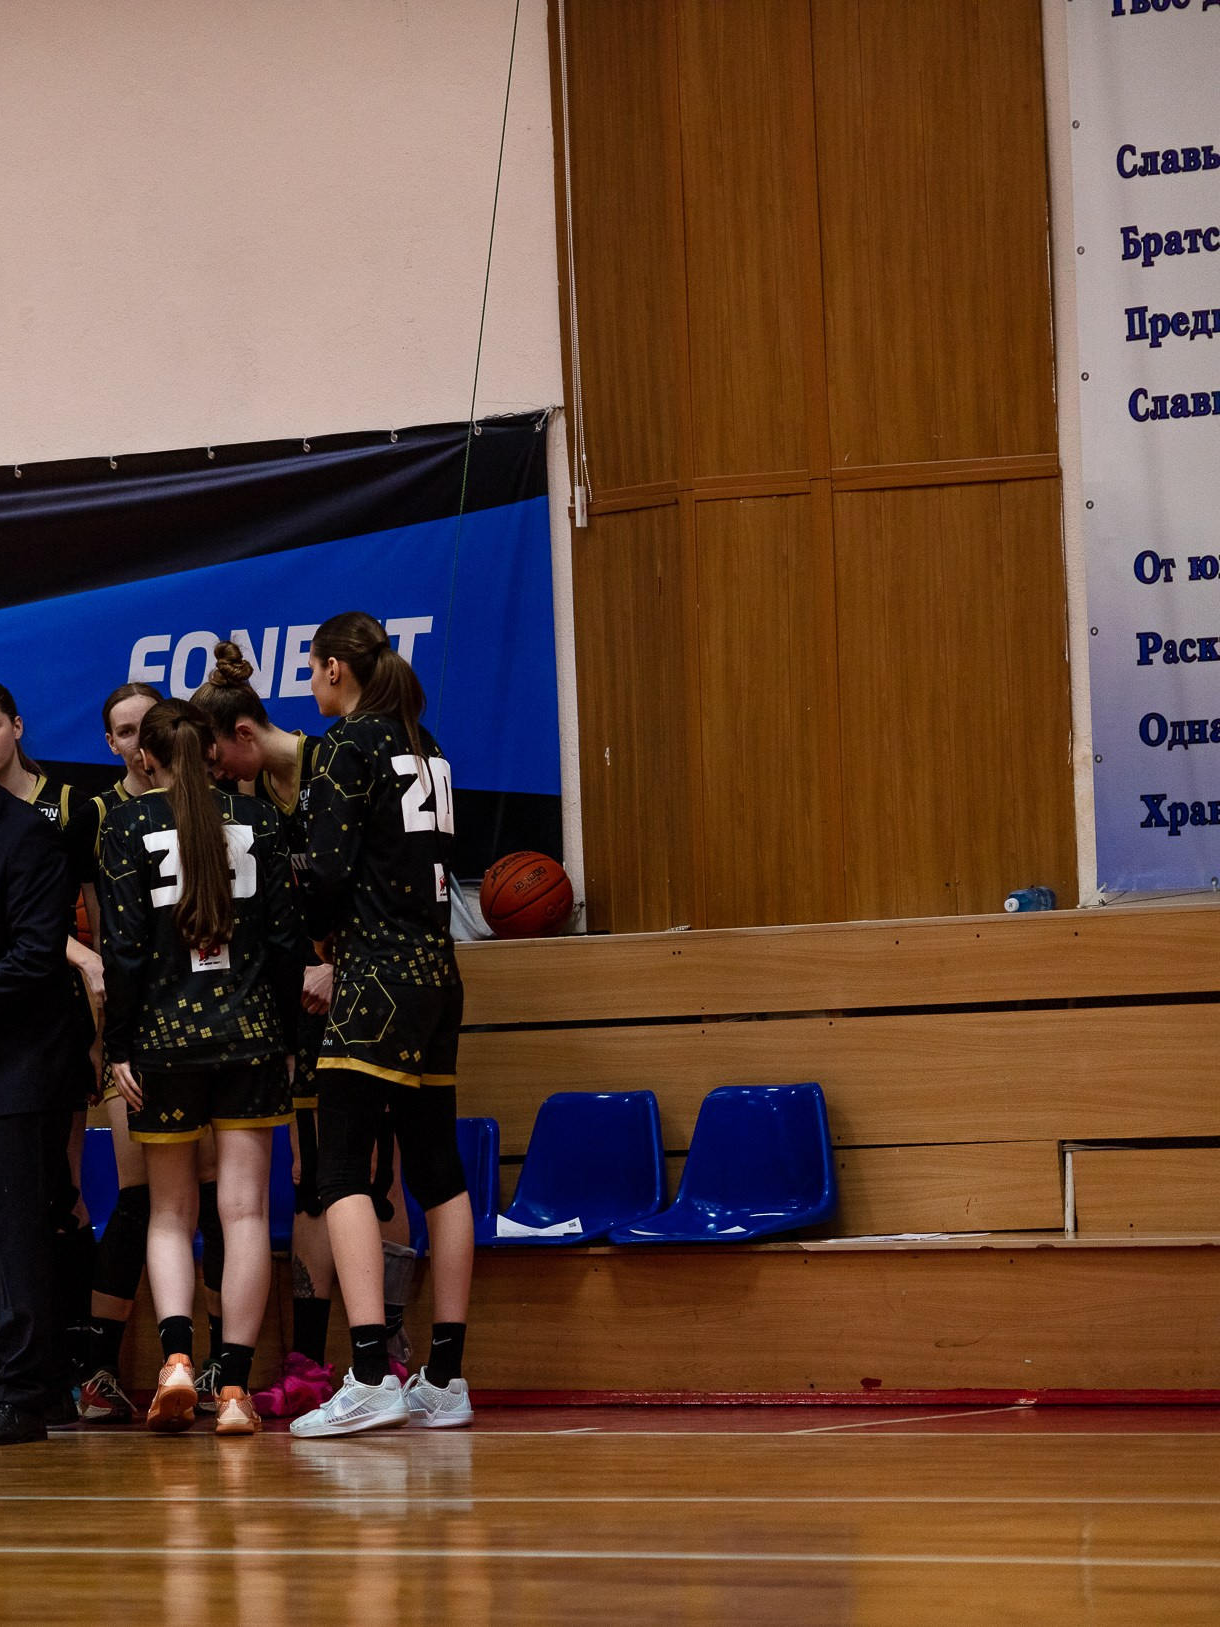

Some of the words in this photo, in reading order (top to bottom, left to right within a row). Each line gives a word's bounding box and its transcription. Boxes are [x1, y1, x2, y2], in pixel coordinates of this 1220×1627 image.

[1120, 225, 1220, 267] Братс
[1134, 550, 1176, 585] От
[1188, 554, 1220, 581] ю
[127, 615, 434, 701] FONBT
[391, 754, 455, 836] 20
[142, 824, 257, 908] 33
